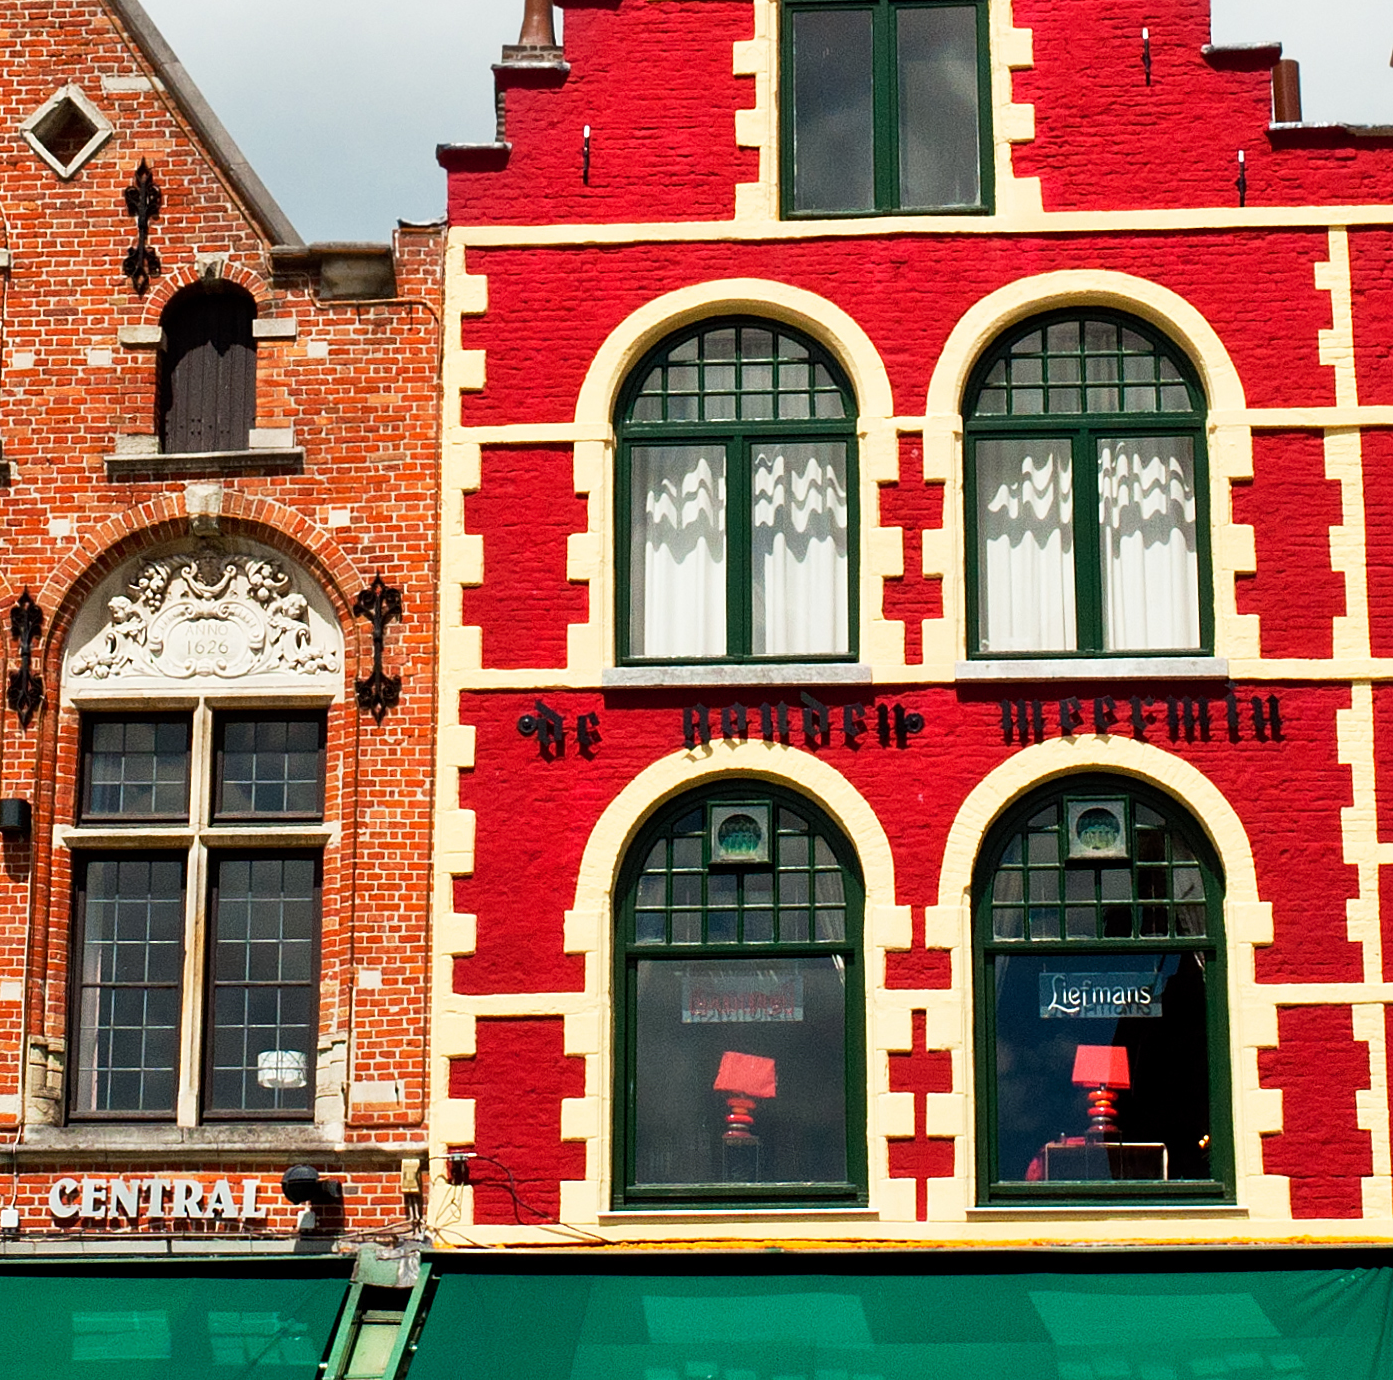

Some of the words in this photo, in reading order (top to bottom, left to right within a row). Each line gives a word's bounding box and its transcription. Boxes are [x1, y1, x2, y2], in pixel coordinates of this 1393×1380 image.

[186, 624, 228, 636] ANNO
[187, 640, 228, 655] 1626
[534, 700, 602, 746] de
[682, 691, 908, 752] gouden
[1000, 681, 1284, 732] meermin
[1048, 974, 1152, 1013] Liefmans
[48, 1177, 266, 1219] CENTRAL
